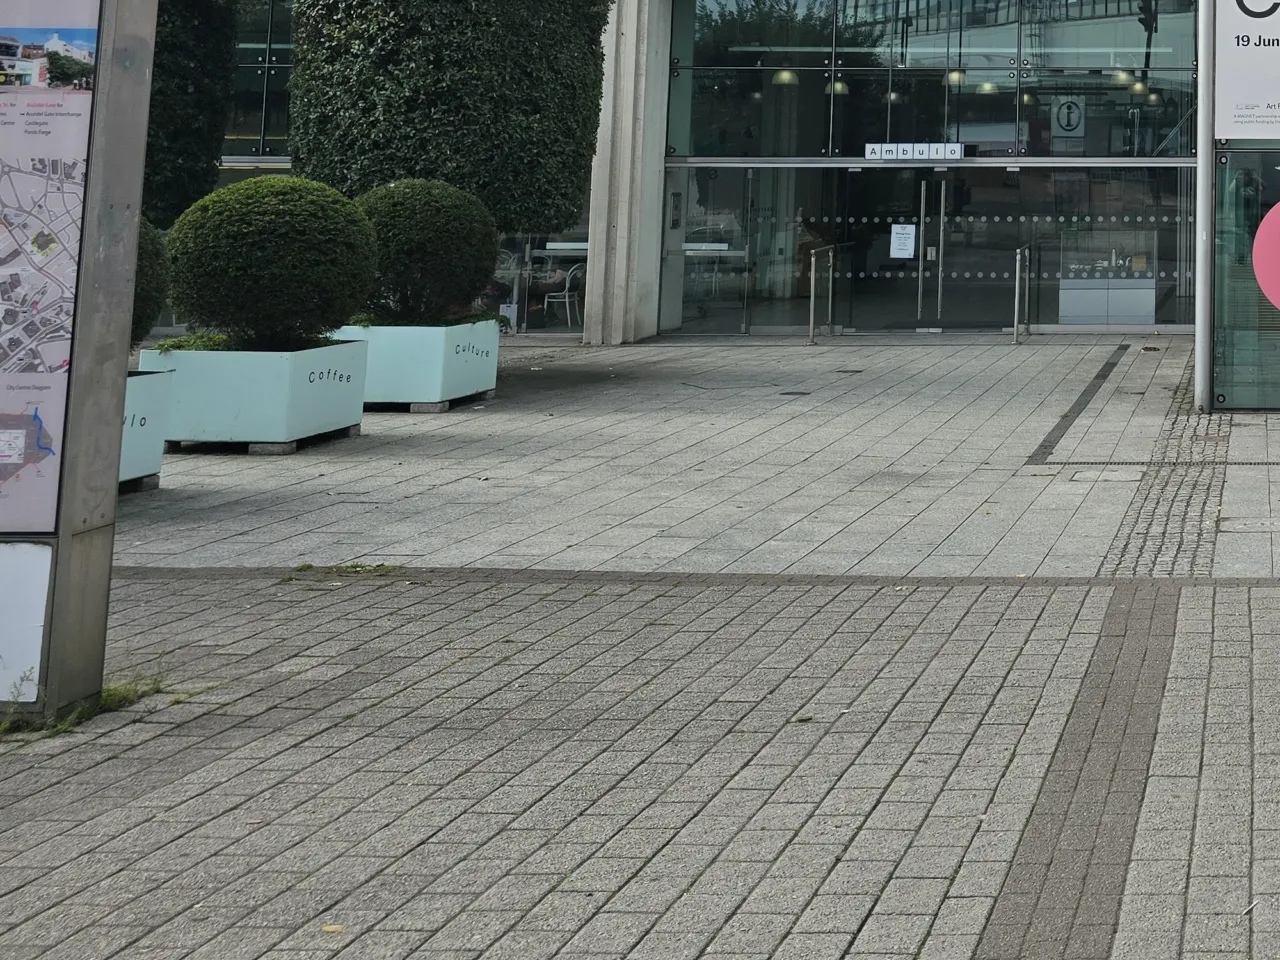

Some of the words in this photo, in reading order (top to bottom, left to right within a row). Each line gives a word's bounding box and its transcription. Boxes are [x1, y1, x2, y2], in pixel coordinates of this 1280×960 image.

[1235, 35, 1251, 47] 19
[1266, 102, 1277, 110] Art
[870, 147, 956, 156] Ambulo
[455, 342, 490, 358] Culture
[308, 368, 352, 384] Coffee
